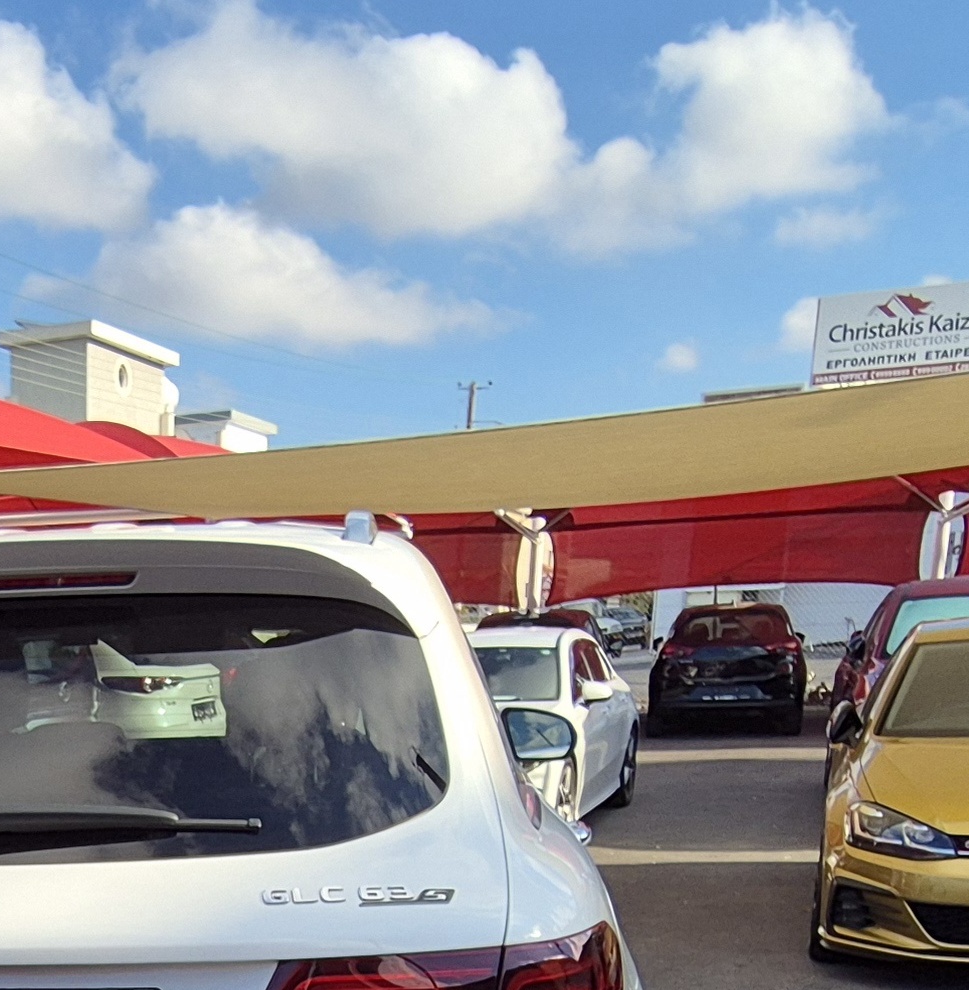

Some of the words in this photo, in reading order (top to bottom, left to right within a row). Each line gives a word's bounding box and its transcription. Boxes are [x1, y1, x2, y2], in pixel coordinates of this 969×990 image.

[829, 318, 924, 343] Christakis
[929, 313, 969, 333] Kaiz
[853, 334, 961, 353] CONSTRUCTIONS
[261, 885, 347, 906] GLC
